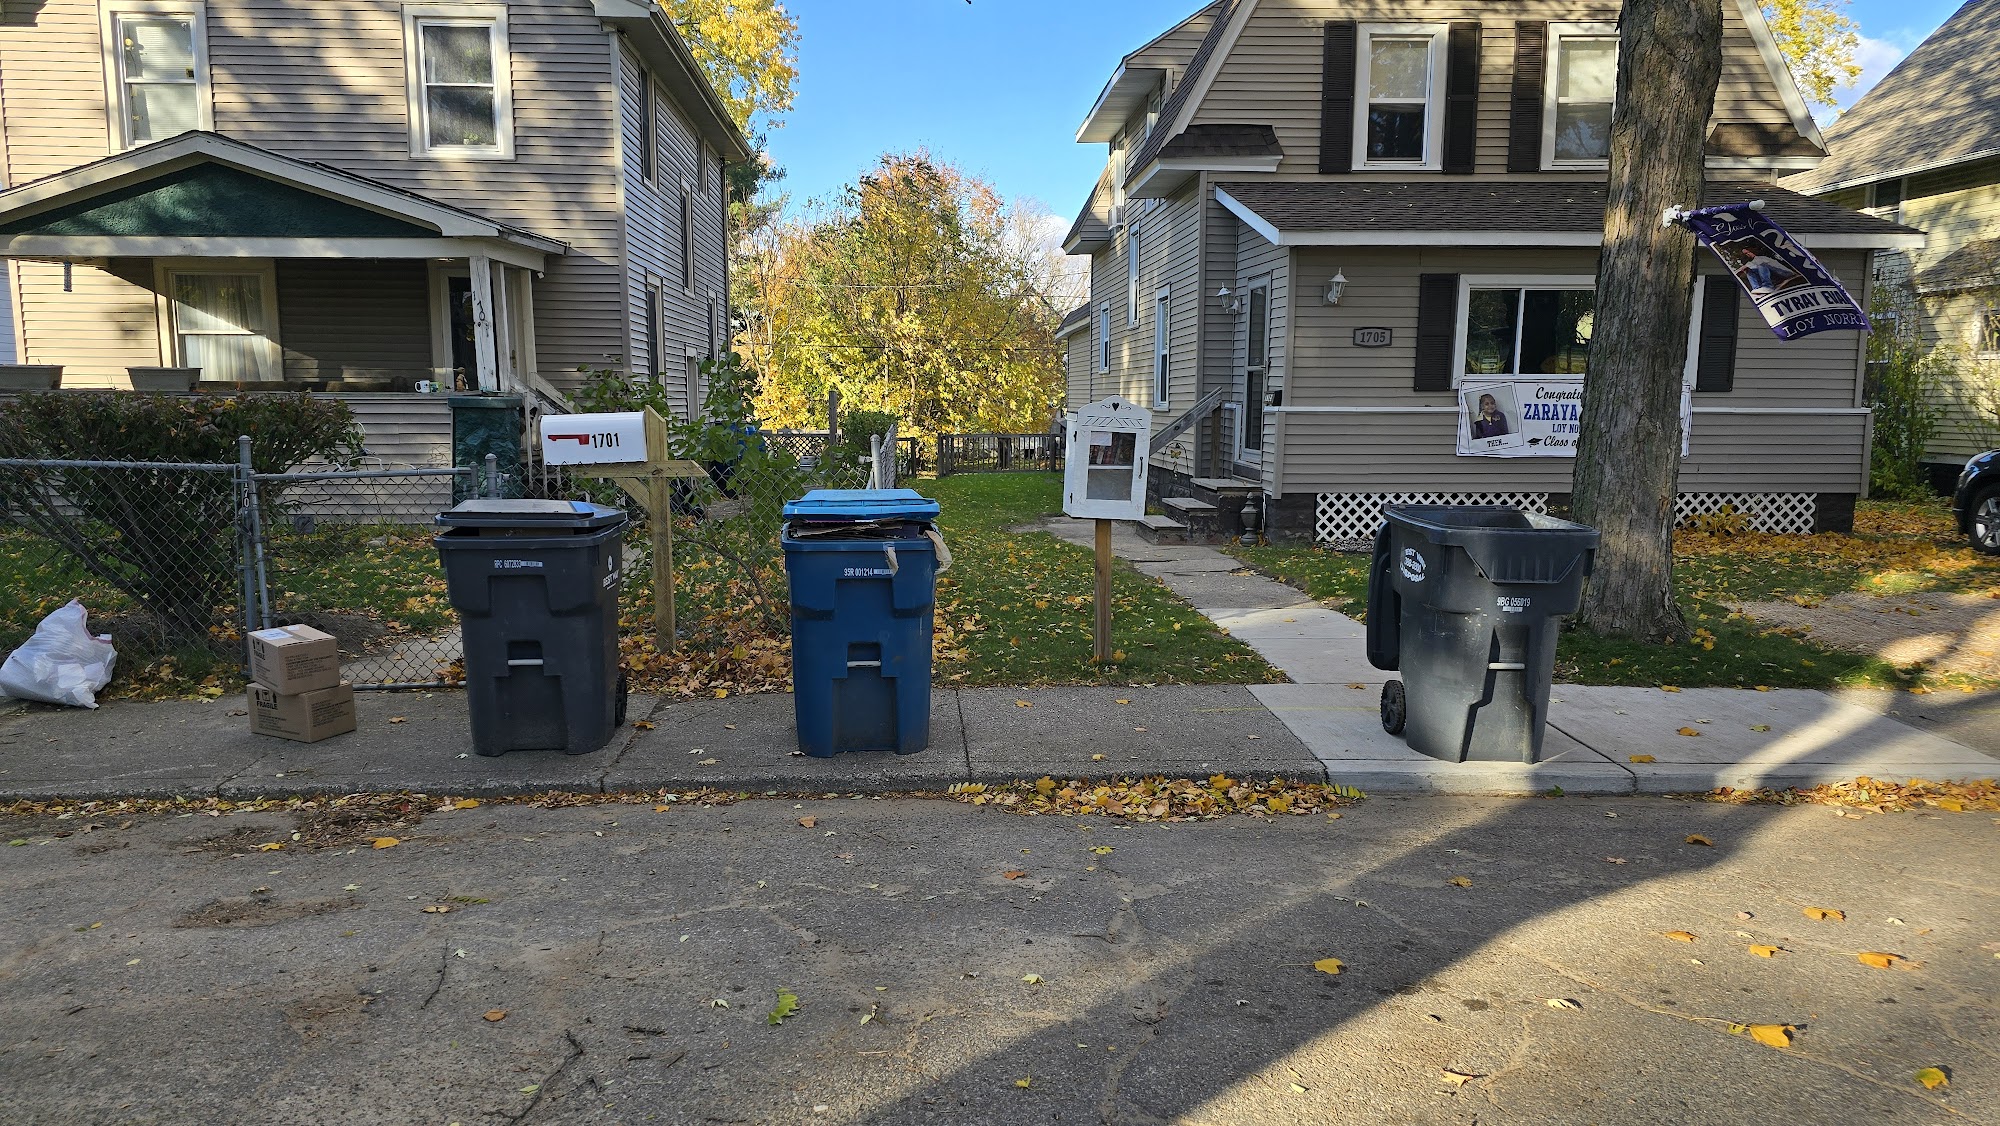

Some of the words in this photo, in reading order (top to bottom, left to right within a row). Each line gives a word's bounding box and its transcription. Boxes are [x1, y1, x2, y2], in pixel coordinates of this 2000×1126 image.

[1771, 291, 1821, 317] TYRAY
[1782, 317, 1815, 338] LOY
[1360, 331, 1386, 343] 1705
[1524, 403, 1578, 421] ZARAYA
[1552, 423, 1567, 433] LOY
[591, 432, 620, 449] 1701
[1543, 435, 1568, 447] Class
[256, 700, 278, 711] FRAGILE
